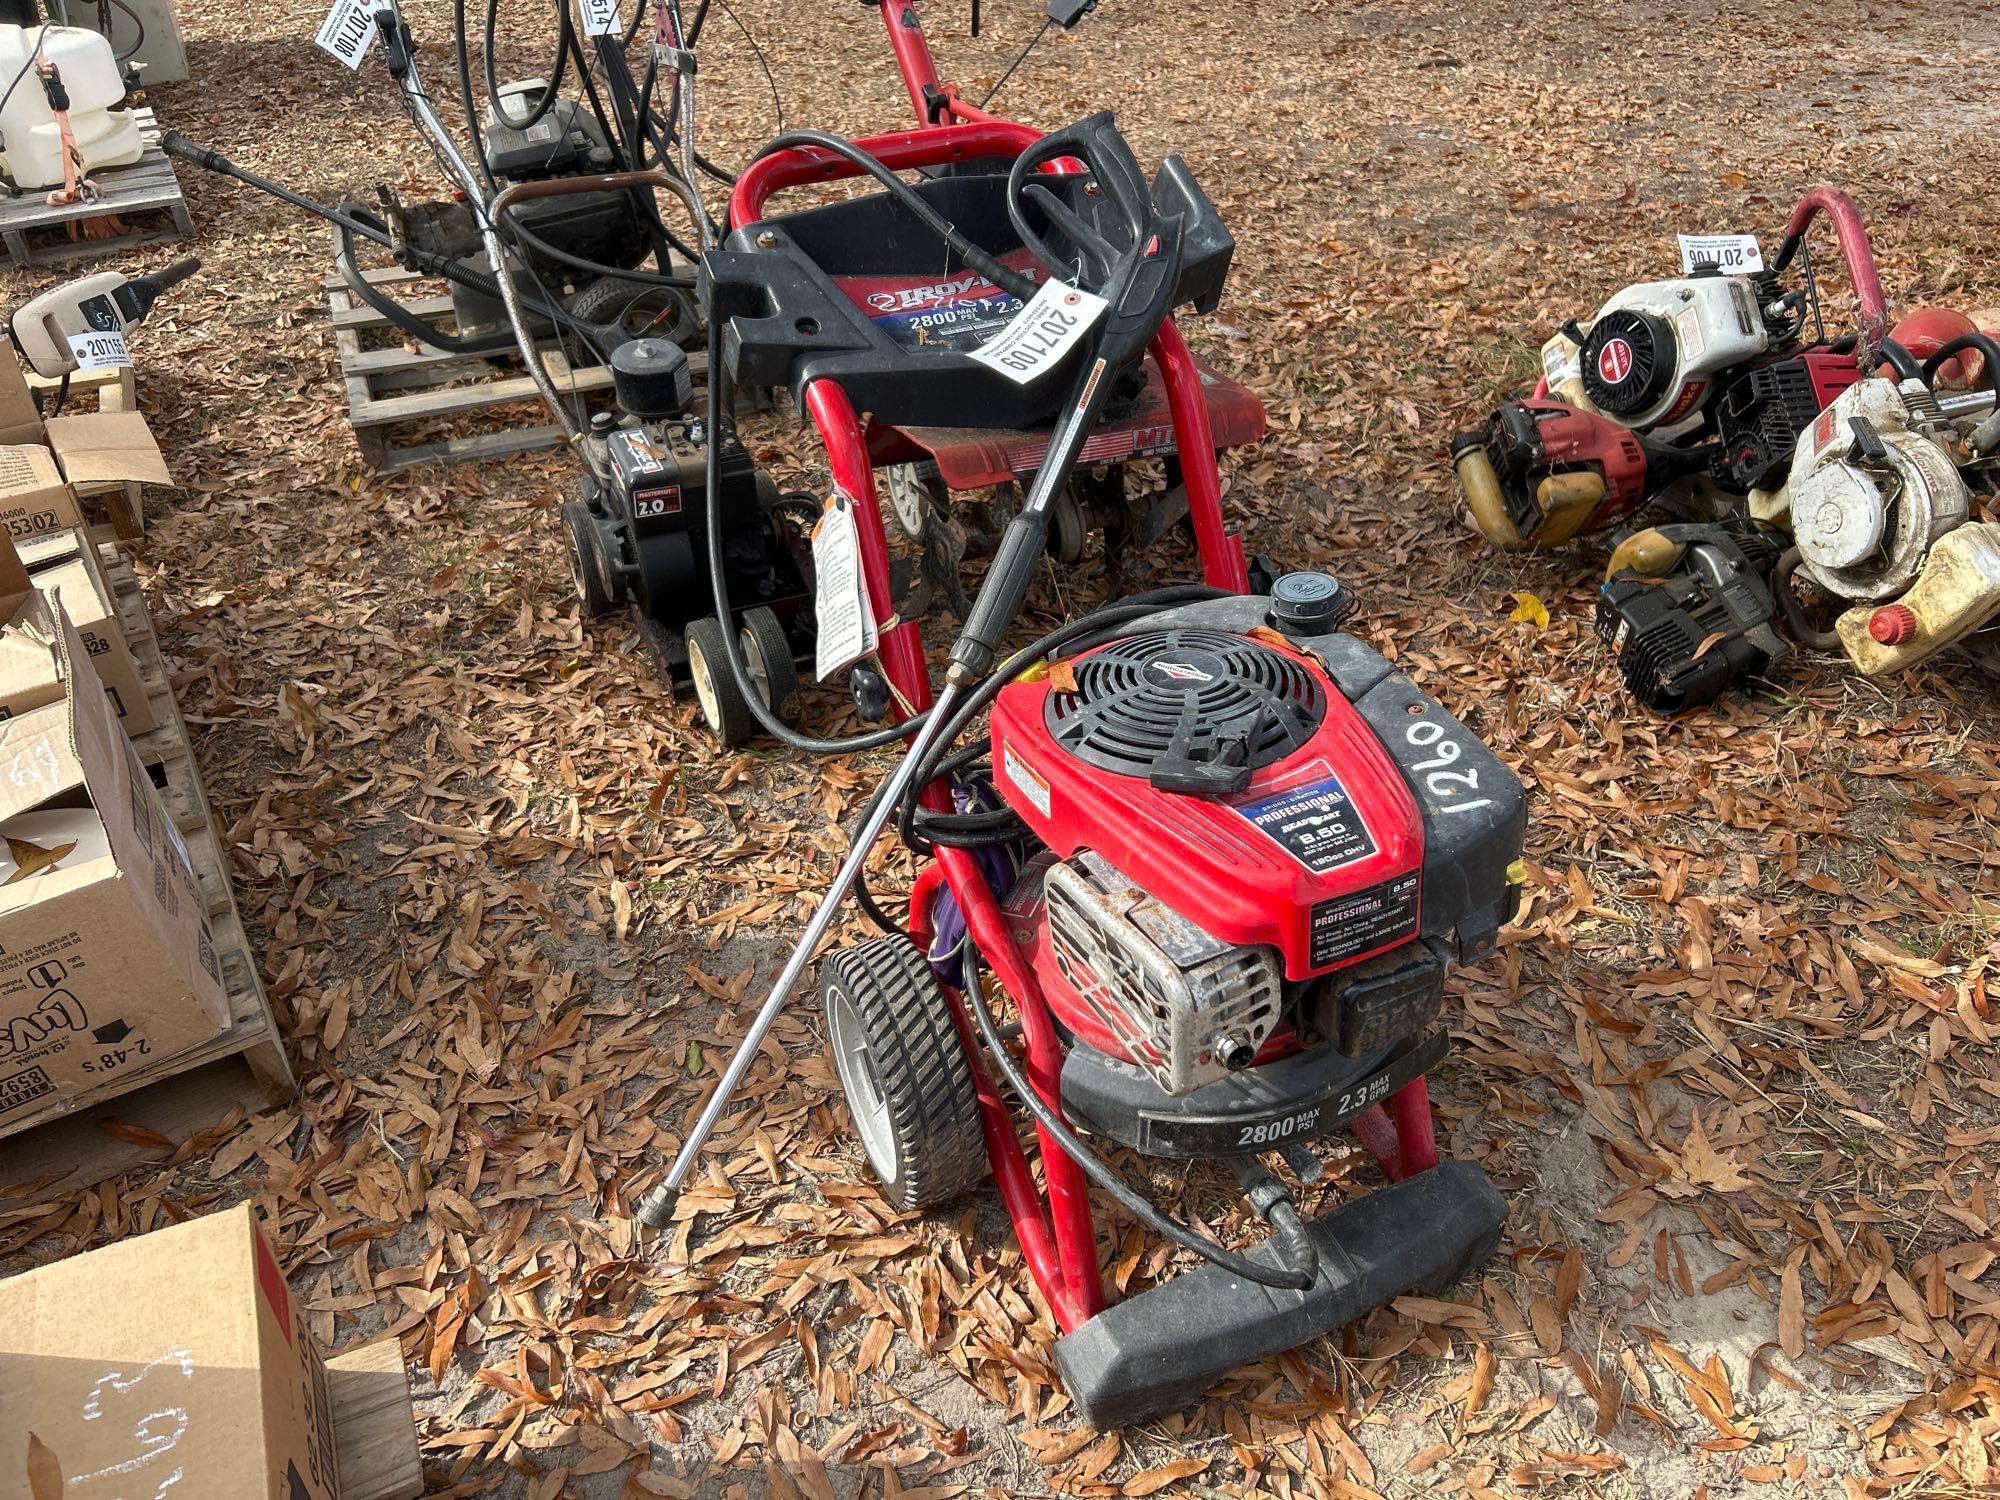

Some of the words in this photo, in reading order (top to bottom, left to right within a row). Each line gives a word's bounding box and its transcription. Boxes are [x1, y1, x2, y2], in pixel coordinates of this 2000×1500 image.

[334, 6, 372, 58] 207108
[956, 306, 979, 316] MAX
[996, 298, 1025, 314] 2.3
[909, 310, 957, 330] 2800
[960, 313, 977, 321] PSI
[87, 338, 126, 356] 207155
[1000, 309, 1078, 371] 207109
[1911, 453, 1940, 495] CAUTION
[639, 499, 665, 516] 2.0
[1406, 721, 1492, 813] 1260
[1254, 791, 1345, 826] PROFESSIONAL
[1299, 822, 1347, 845] 8.50
[1343, 844, 1366, 856] OHV
[1315, 899, 1383, 928] PROFESSIONAL
[1330, 937, 1364, 951] TECHNOLOGY
[1392, 916, 1416, 930] MUFFLER
[81, 1038, 152, 1073] 2-48's
[1369, 1073, 1391, 1092] MAX
[1369, 1083, 1390, 1101] GPM
[1337, 1086, 1368, 1116] 2.3
[1296, 1106, 1321, 1124] MAX
[1238, 1116, 1295, 1145] 2800
[1297, 1119, 1315, 1133] PSI
